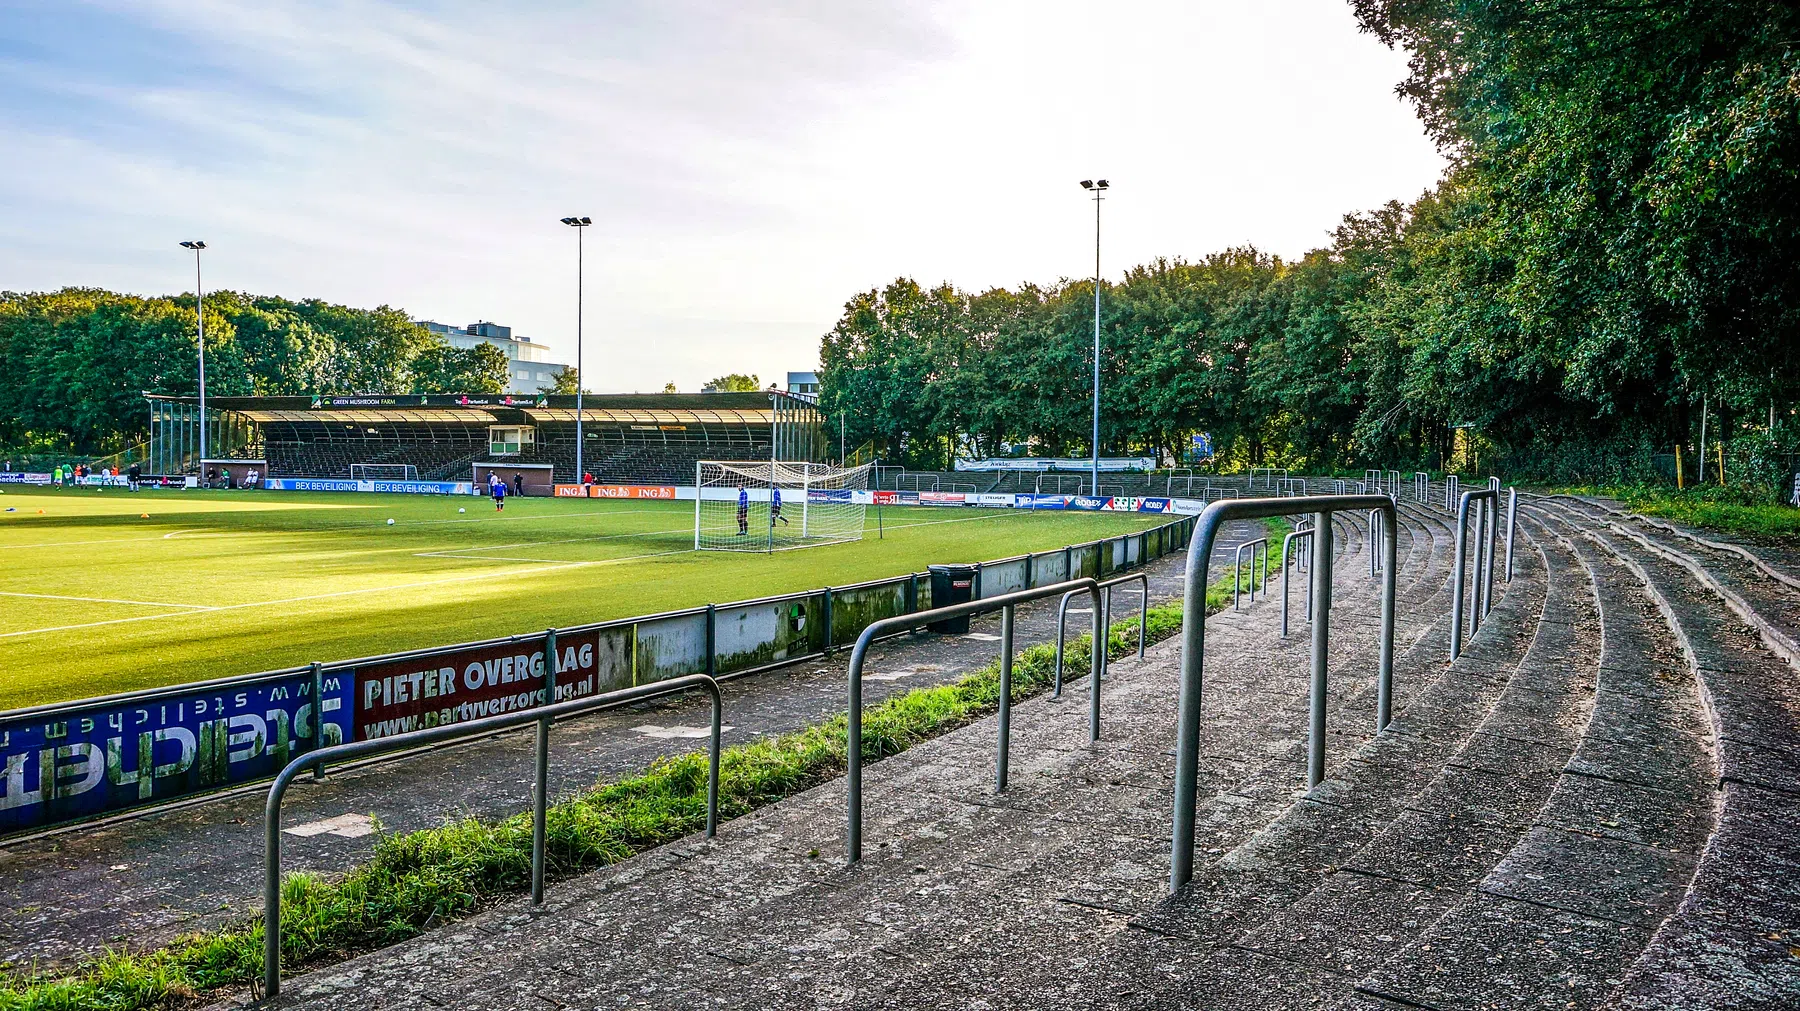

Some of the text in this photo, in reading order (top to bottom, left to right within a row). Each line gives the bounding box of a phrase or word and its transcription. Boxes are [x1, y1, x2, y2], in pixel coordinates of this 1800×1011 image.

[295, 481, 311, 490] BEX
[311, 482, 357, 491] BEVEILIGING
[375, 483, 391, 492] BEX
[392, 484, 440, 493] BEVEILIGING
[559, 487, 578, 496] ING
[598, 488, 619, 497] ING
[639, 489, 660, 498] ING
[364, 667, 457, 710] PIETER
[364, 674, 593, 740] www.partyverzorgng.nl
